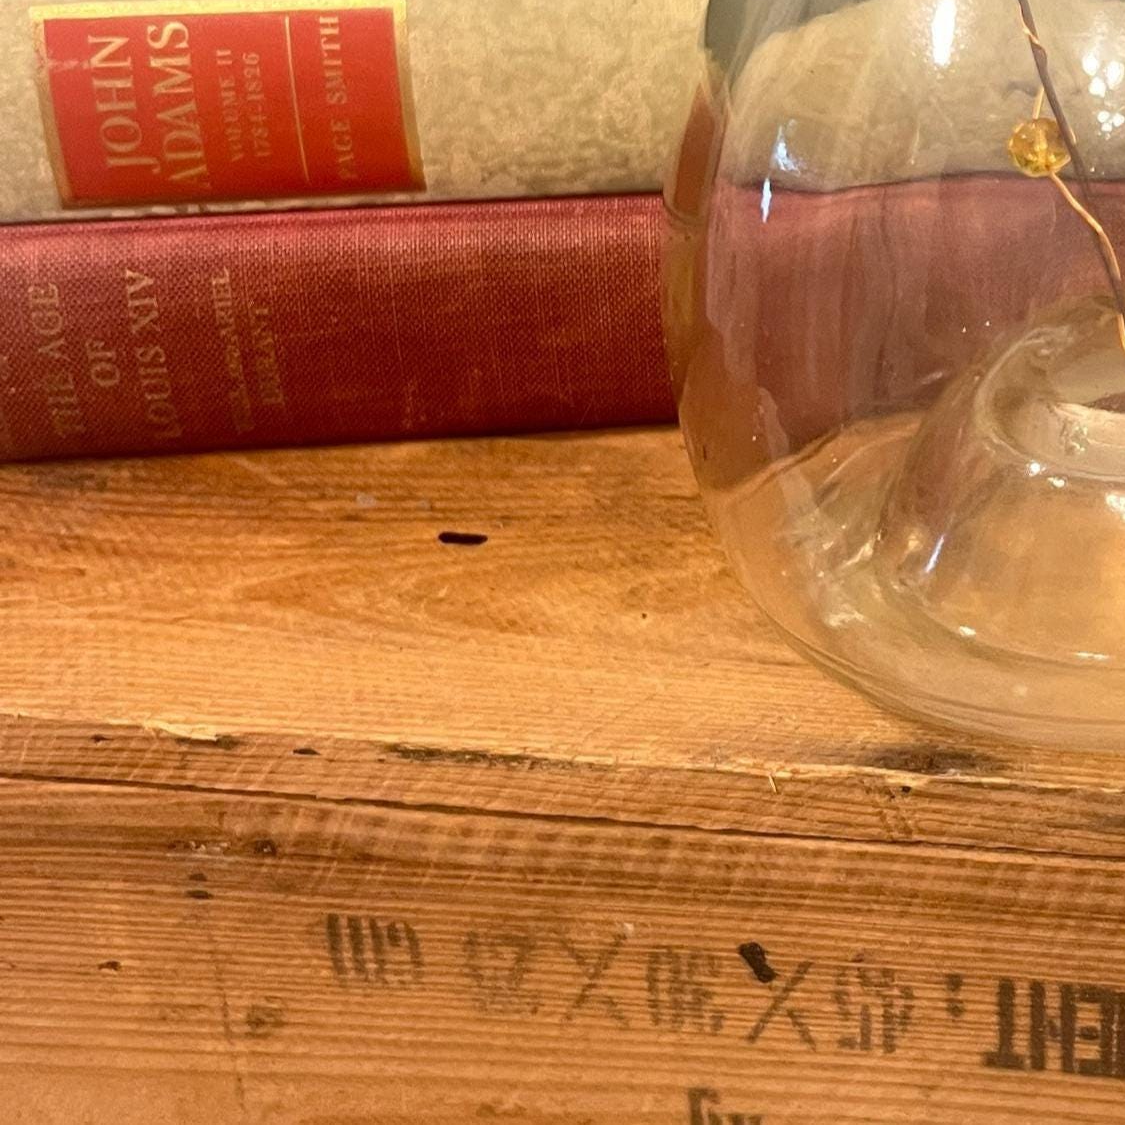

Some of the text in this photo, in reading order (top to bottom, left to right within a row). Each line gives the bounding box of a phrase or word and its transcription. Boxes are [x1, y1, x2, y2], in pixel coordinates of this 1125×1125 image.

[87, 34, 161, 174] JOHN
[146, 20, 211, 192] ADAMS
[215, 48, 234, 66] II
[317, 15, 360, 182] PAGE SMITH
[27, 282, 86, 440] THE AGE
[84, 338, 121, 388] OF
[124, 268, 184, 440] LOUIS XIV
